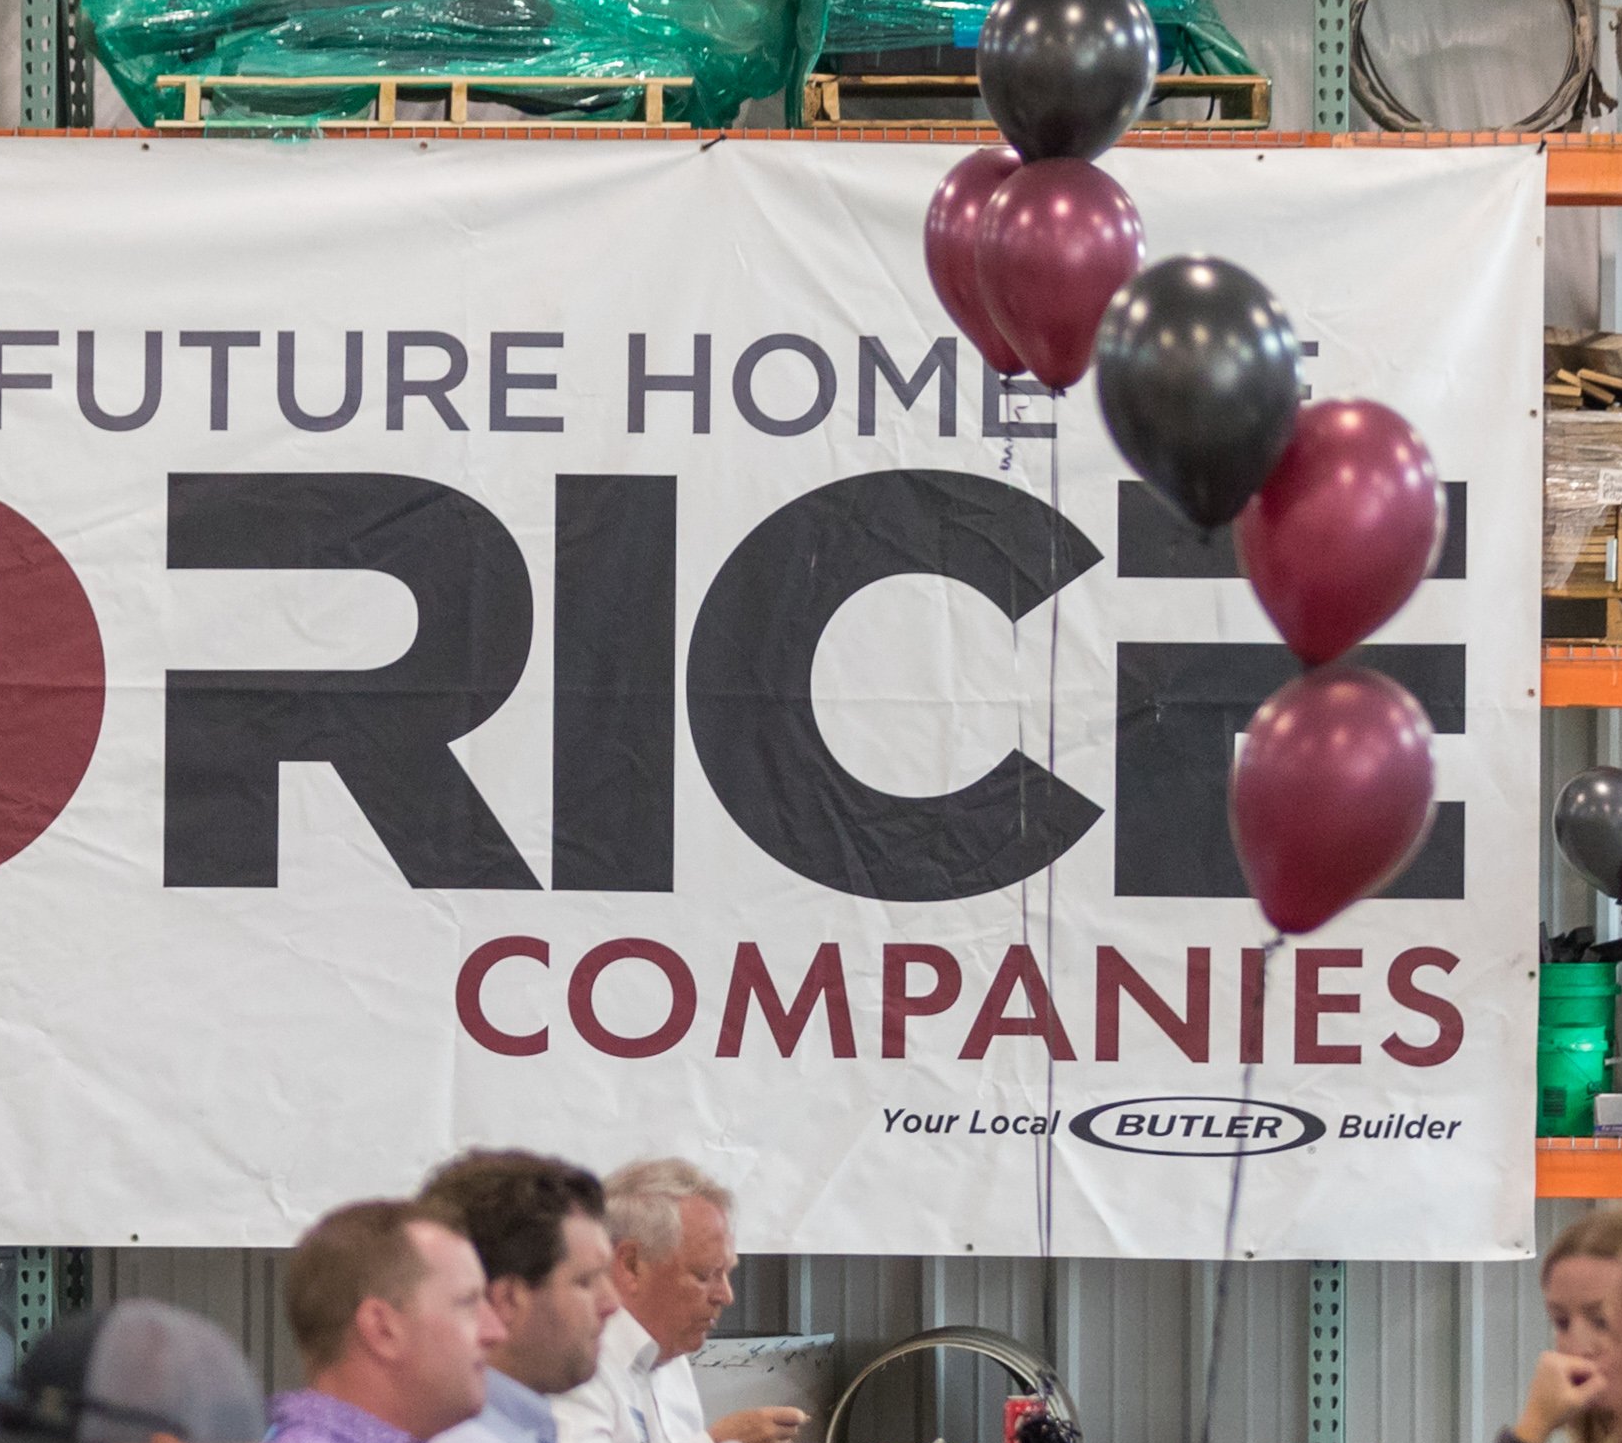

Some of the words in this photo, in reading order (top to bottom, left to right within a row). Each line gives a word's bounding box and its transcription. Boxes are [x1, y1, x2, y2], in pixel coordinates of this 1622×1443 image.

[627, 331, 1058, 438] HOME
[163, 469, 1467, 902] RICE
[454, 935, 1467, 1068] COMPANIES
[881, 1108, 960, 1136] Your
[968, 1108, 1062, 1136] Local
[1114, 1113, 1281, 1140] BUTLER
[1338, 1113, 1462, 1141] Builder
